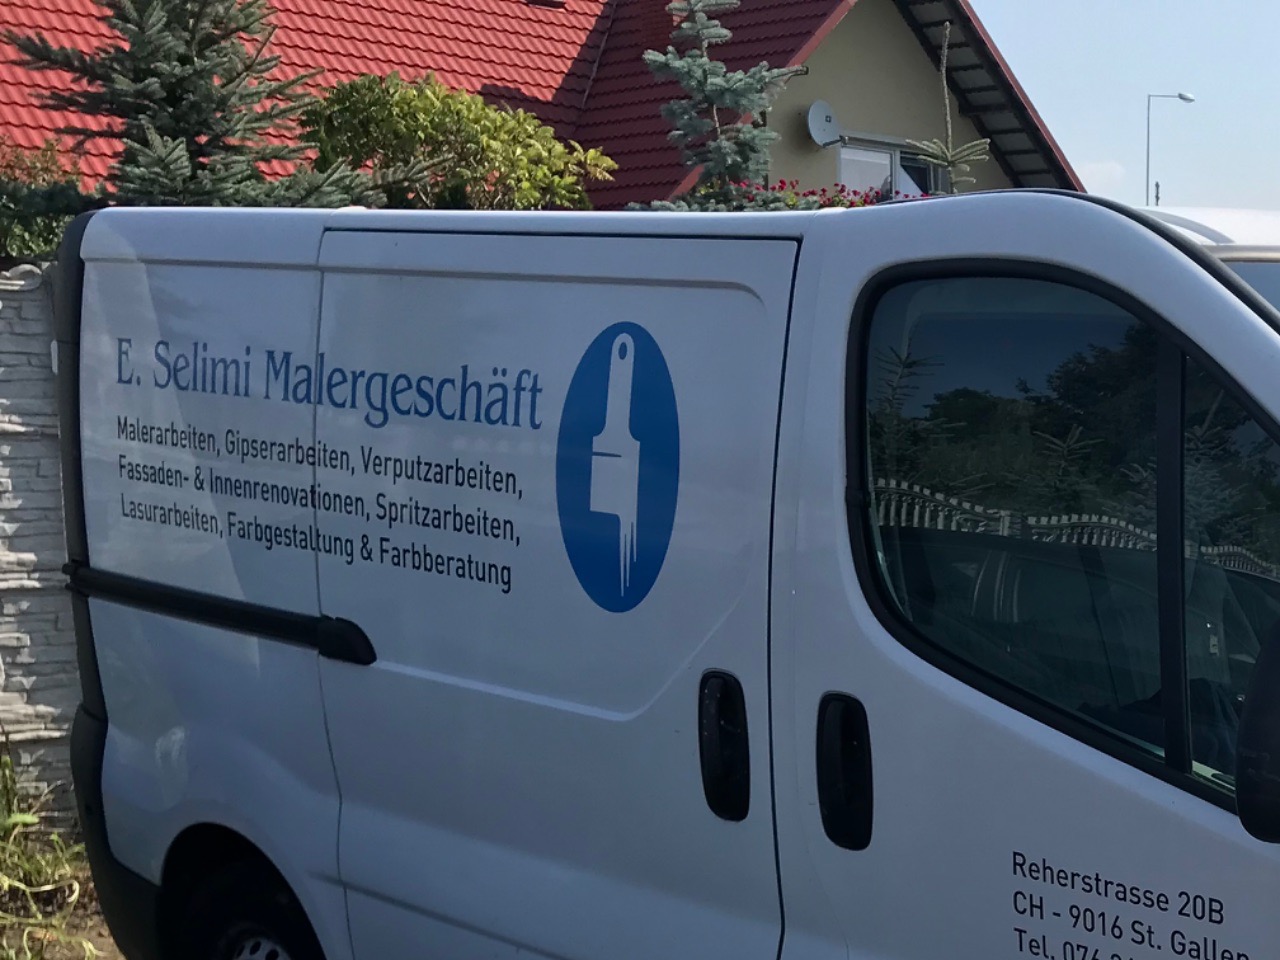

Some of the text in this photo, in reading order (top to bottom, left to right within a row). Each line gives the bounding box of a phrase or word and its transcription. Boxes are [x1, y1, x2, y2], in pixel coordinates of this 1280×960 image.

[117, 337, 543, 430] E. Selimi Malergeschäft
[117, 415, 523, 500] Malerarbeiten, Gipserarbeiten, Verputzarbeiten,
[118, 454, 520, 547] Fassaden- & Innenrenovationen, Spritzarbeiten,
[121, 493, 512, 594] Lasurarbeiten, Farbgestaltung & Farbberatung
[1012, 851, 1225, 925] Reherstrasse 20B
[1012, 890, 1044, 921] CH
[1069, 904, 1123, 940] 9016
[1130, 919, 1163, 951] St.
[1013, 926, 1056, 960] Tel.
